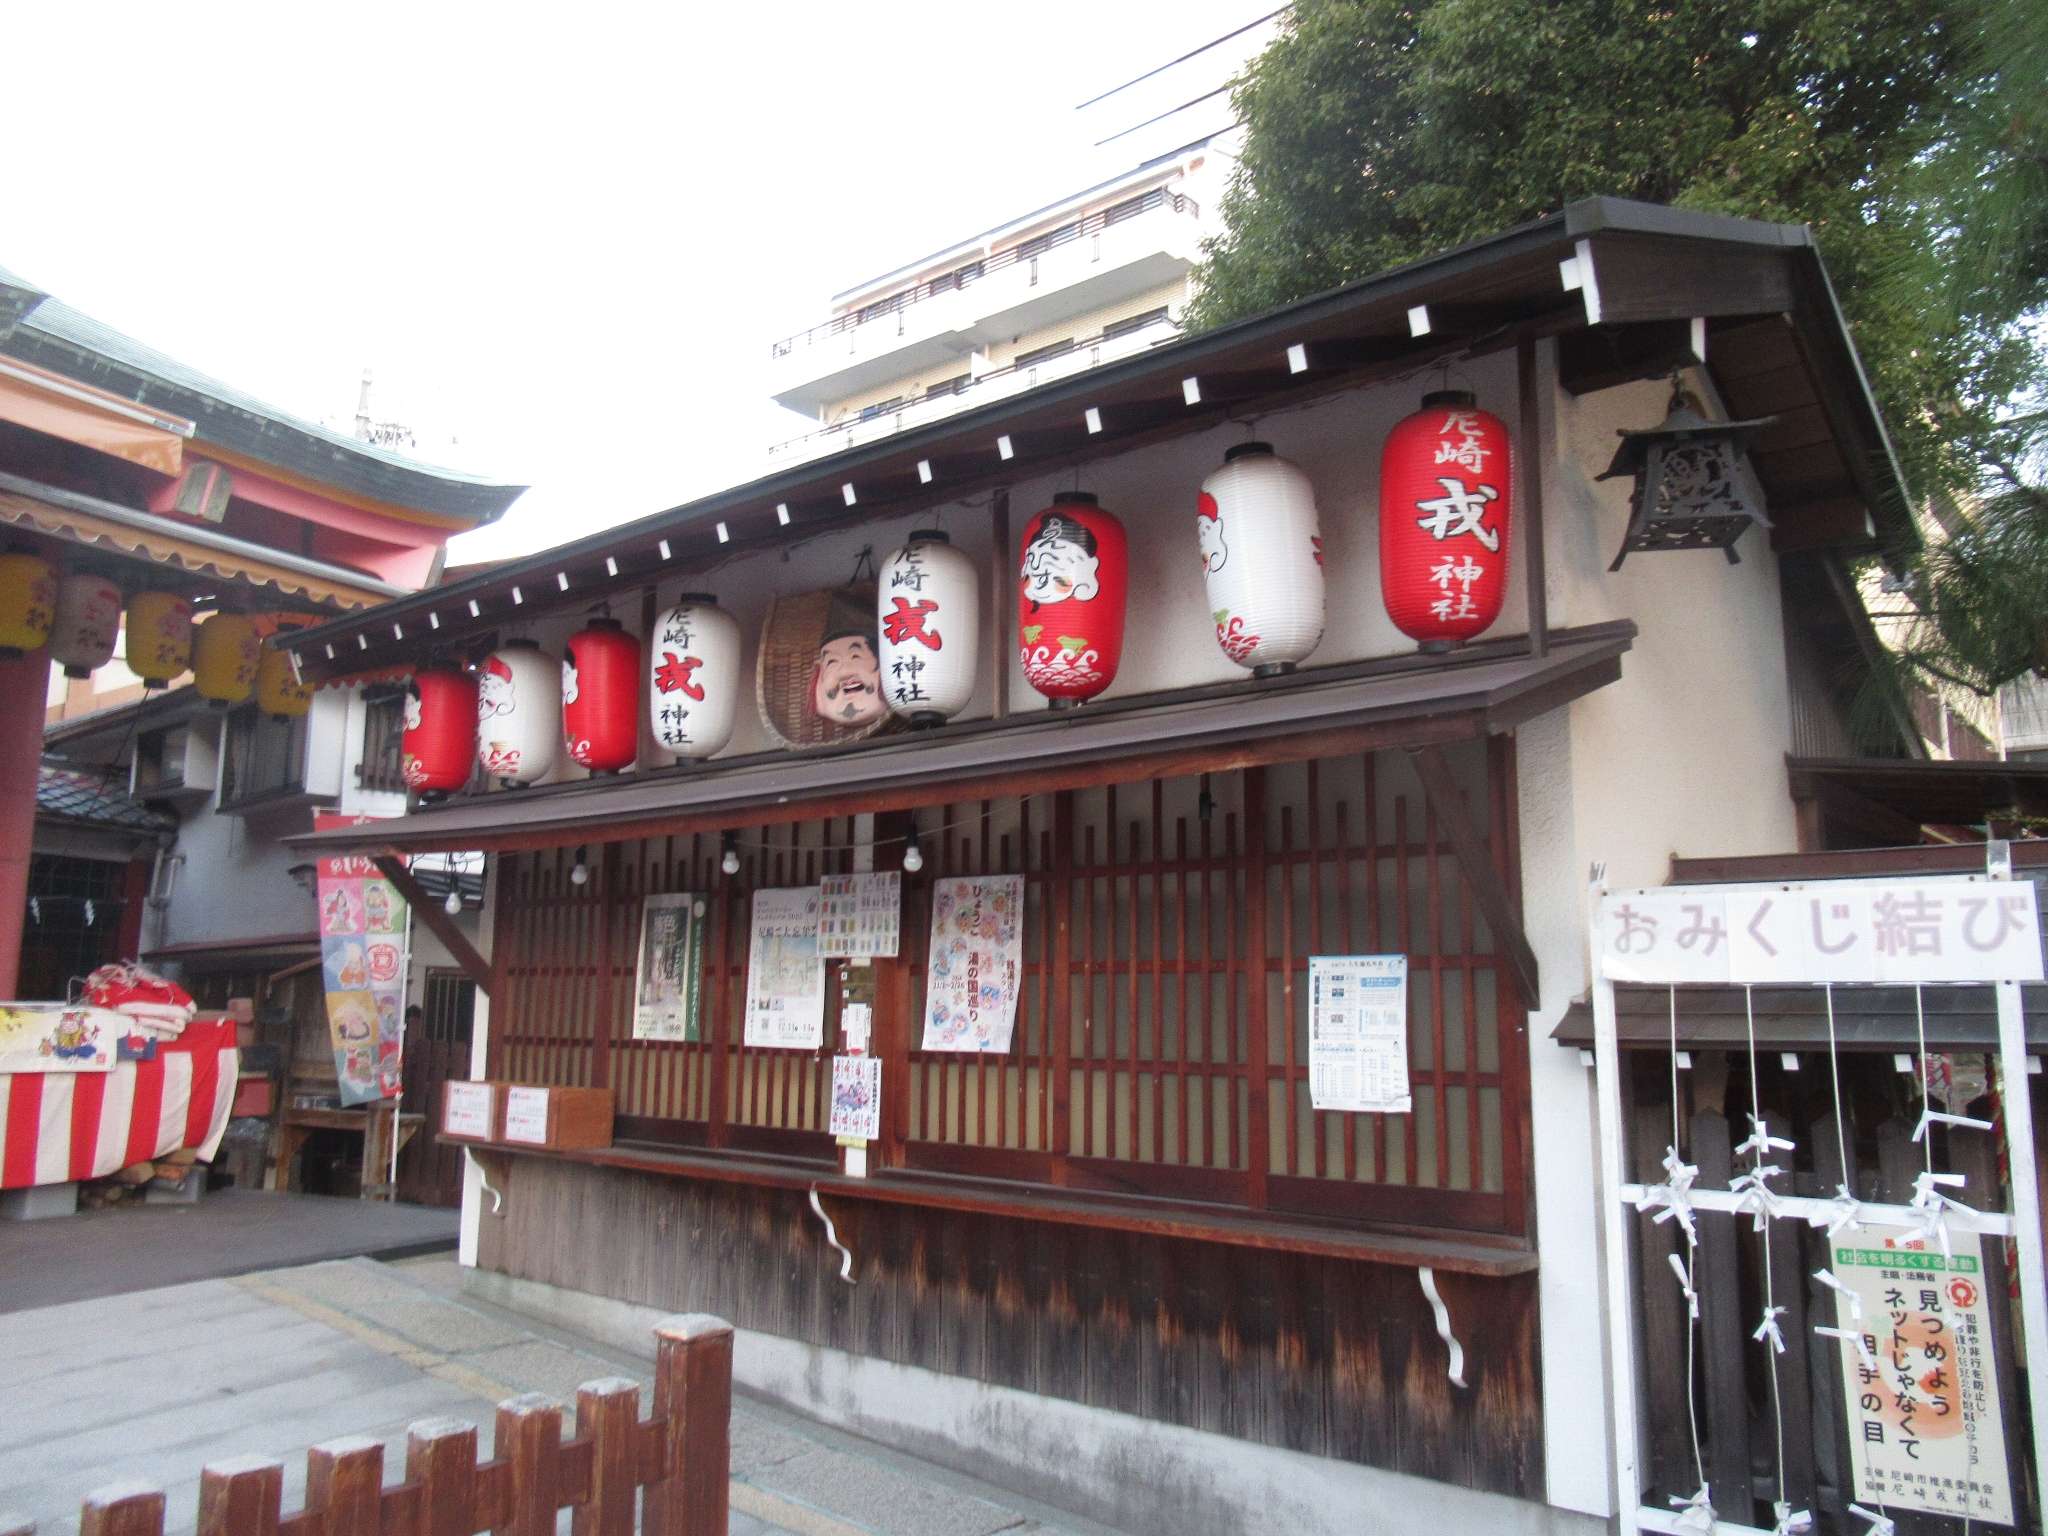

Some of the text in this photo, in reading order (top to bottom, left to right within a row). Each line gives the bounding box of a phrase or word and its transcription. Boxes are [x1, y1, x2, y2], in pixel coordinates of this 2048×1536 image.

[1613, 890, 2028, 957] おみくじ結び
[1884, 1238, 1925, 1250] 第5回
[1884, 1287, 1921, 1460] ネットじゃなくて
[1919, 1289, 1950, 1417] 見つめよう
